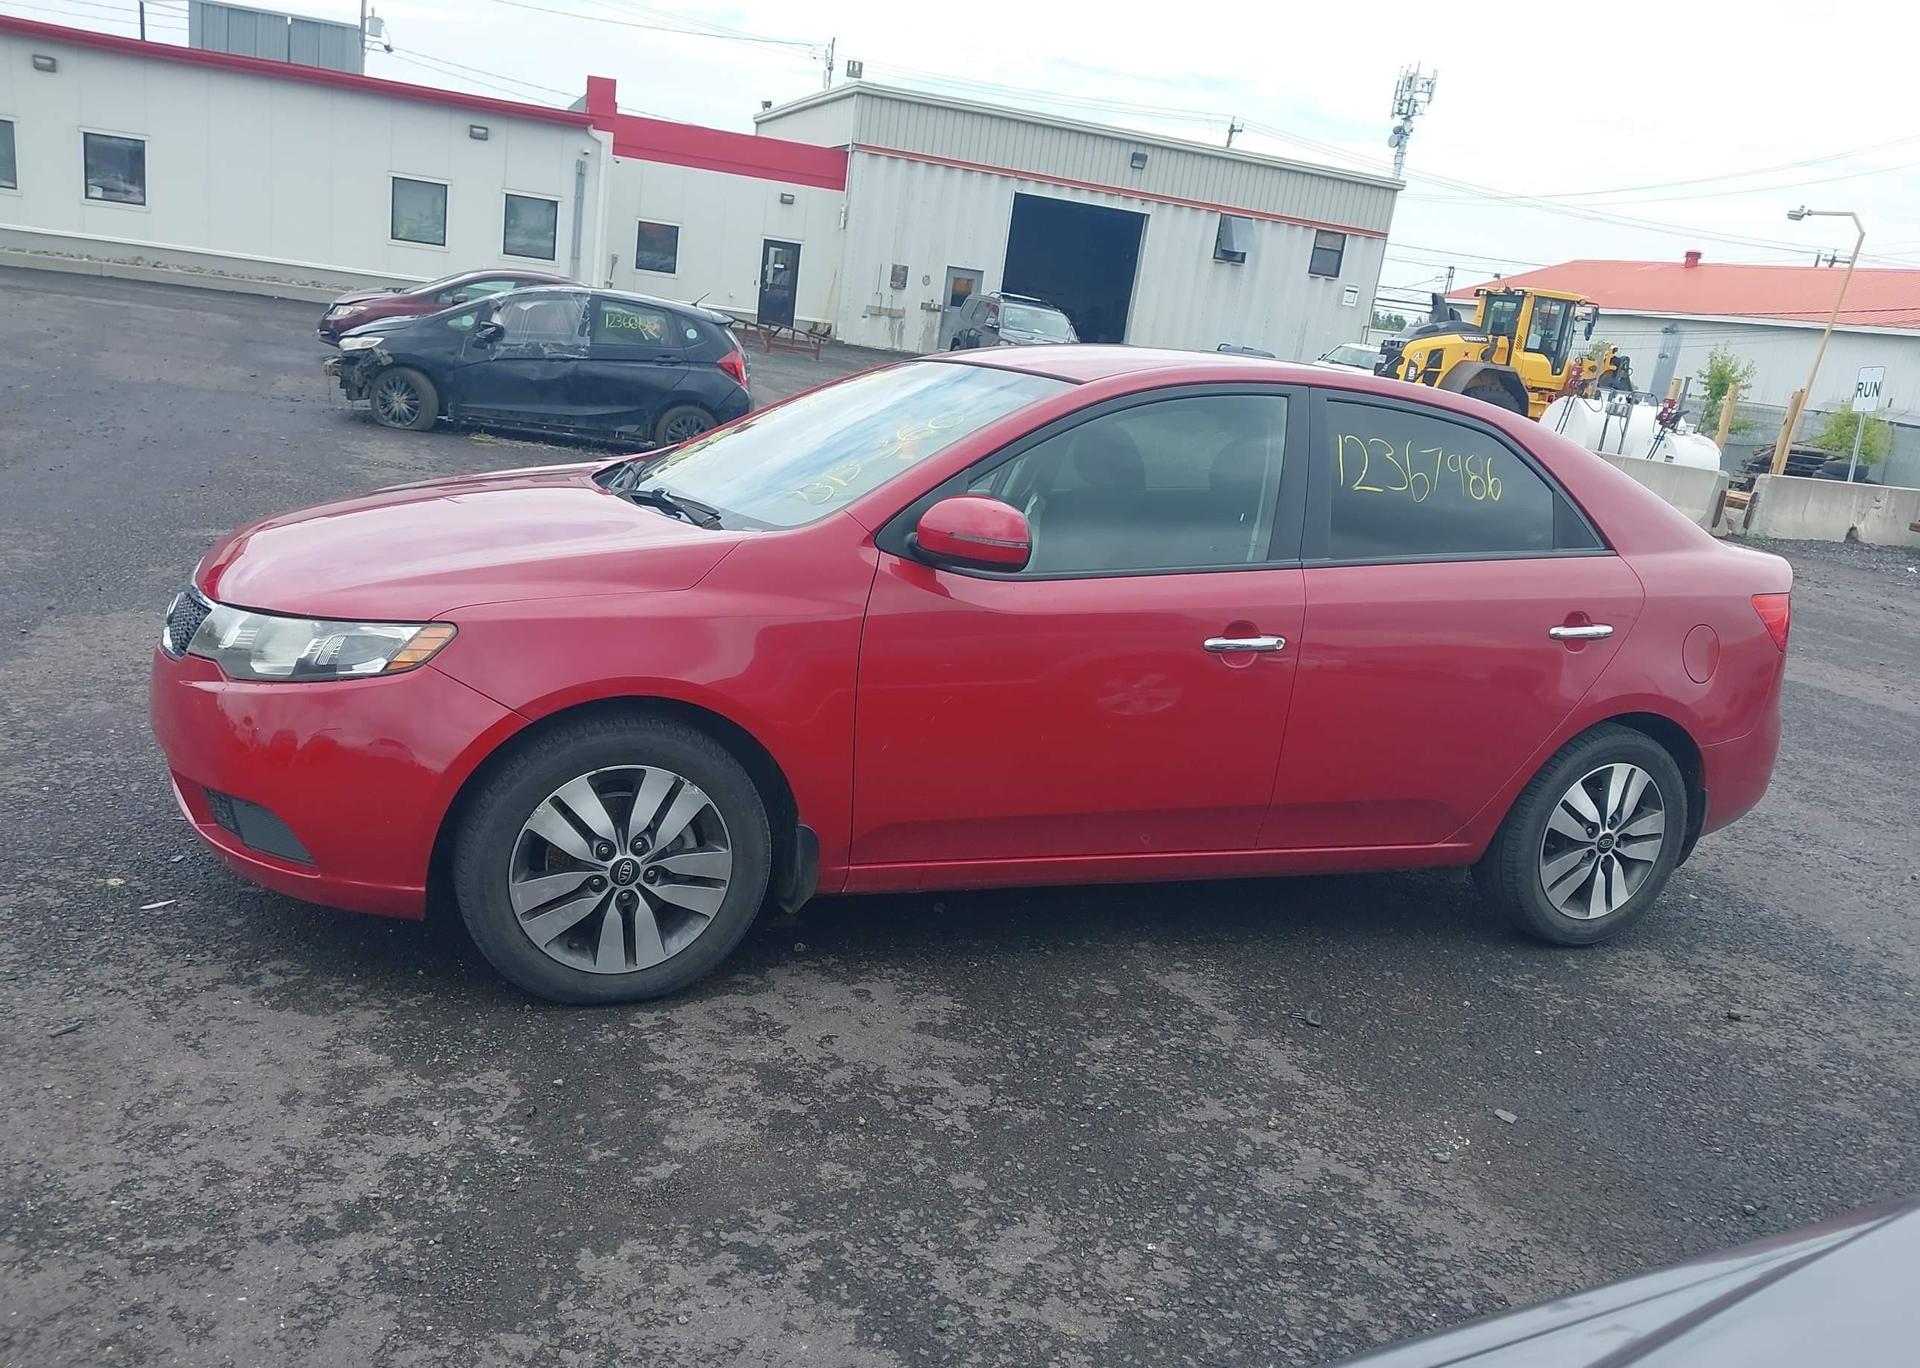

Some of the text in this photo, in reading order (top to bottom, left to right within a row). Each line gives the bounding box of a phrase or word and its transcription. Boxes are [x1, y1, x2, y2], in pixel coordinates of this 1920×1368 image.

[1855, 381, 1881, 398] RUN
[1337, 434, 1502, 502] 12367986
[619, 863, 632, 881] KIA
